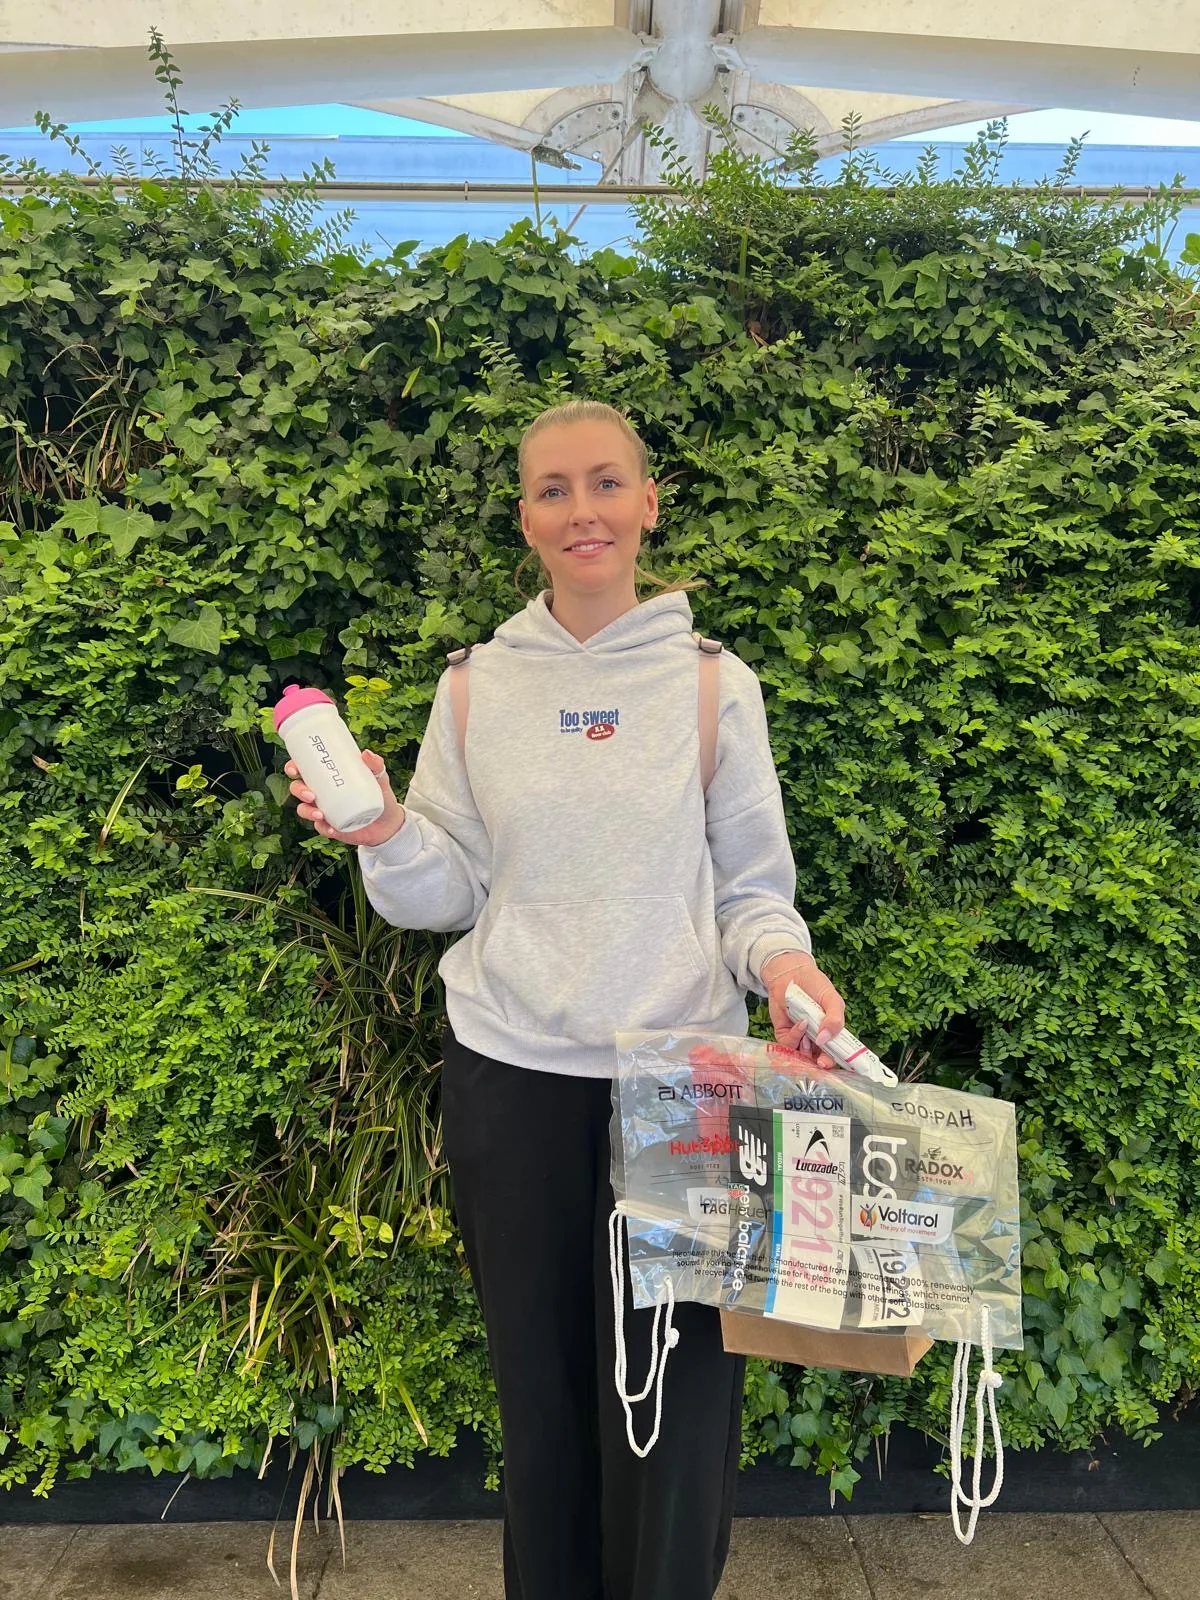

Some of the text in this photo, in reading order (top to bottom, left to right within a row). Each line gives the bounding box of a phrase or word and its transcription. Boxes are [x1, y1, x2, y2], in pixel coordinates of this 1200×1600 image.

[559, 708, 620, 727] Too sweet
[311, 735, 345, 788] truefuels
[680, 1083, 743, 1099] ABBOTT
[783, 1097, 844, 1111] BUXTON
[795, 1159, 838, 1175] Lucozade
[905, 1158, 964, 1180] RADOX
[878, 1205, 938, 1228] Voltarol
[891, 1225, 899, 1233] joy
[907, 1227, 937, 1236] movement
[777, 1258, 828, 1273] manufactured
[830, 1265, 847, 1276] from
[931, 1282, 975, 1296] renewably
[778, 1269, 791, 1277] use
[793, 1269, 803, 1278] for
[812, 1273, 837, 1285] please
[838, 1279, 866, 1290] remove
[868, 1282, 881, 1292] the
[913, 1289, 939, 1300] which
[941, 1293, 970, 1303] cannot
[782, 1278, 793, 1288] the
[795, 1281, 809, 1291] rest
[810, 1283, 818, 1292] of
[819, 1286, 832, 1294] the
[833, 1287, 848, 1299] bag
[850, 1290, 867, 1300] with
[906, 1300, 942, 1312] plastics.
